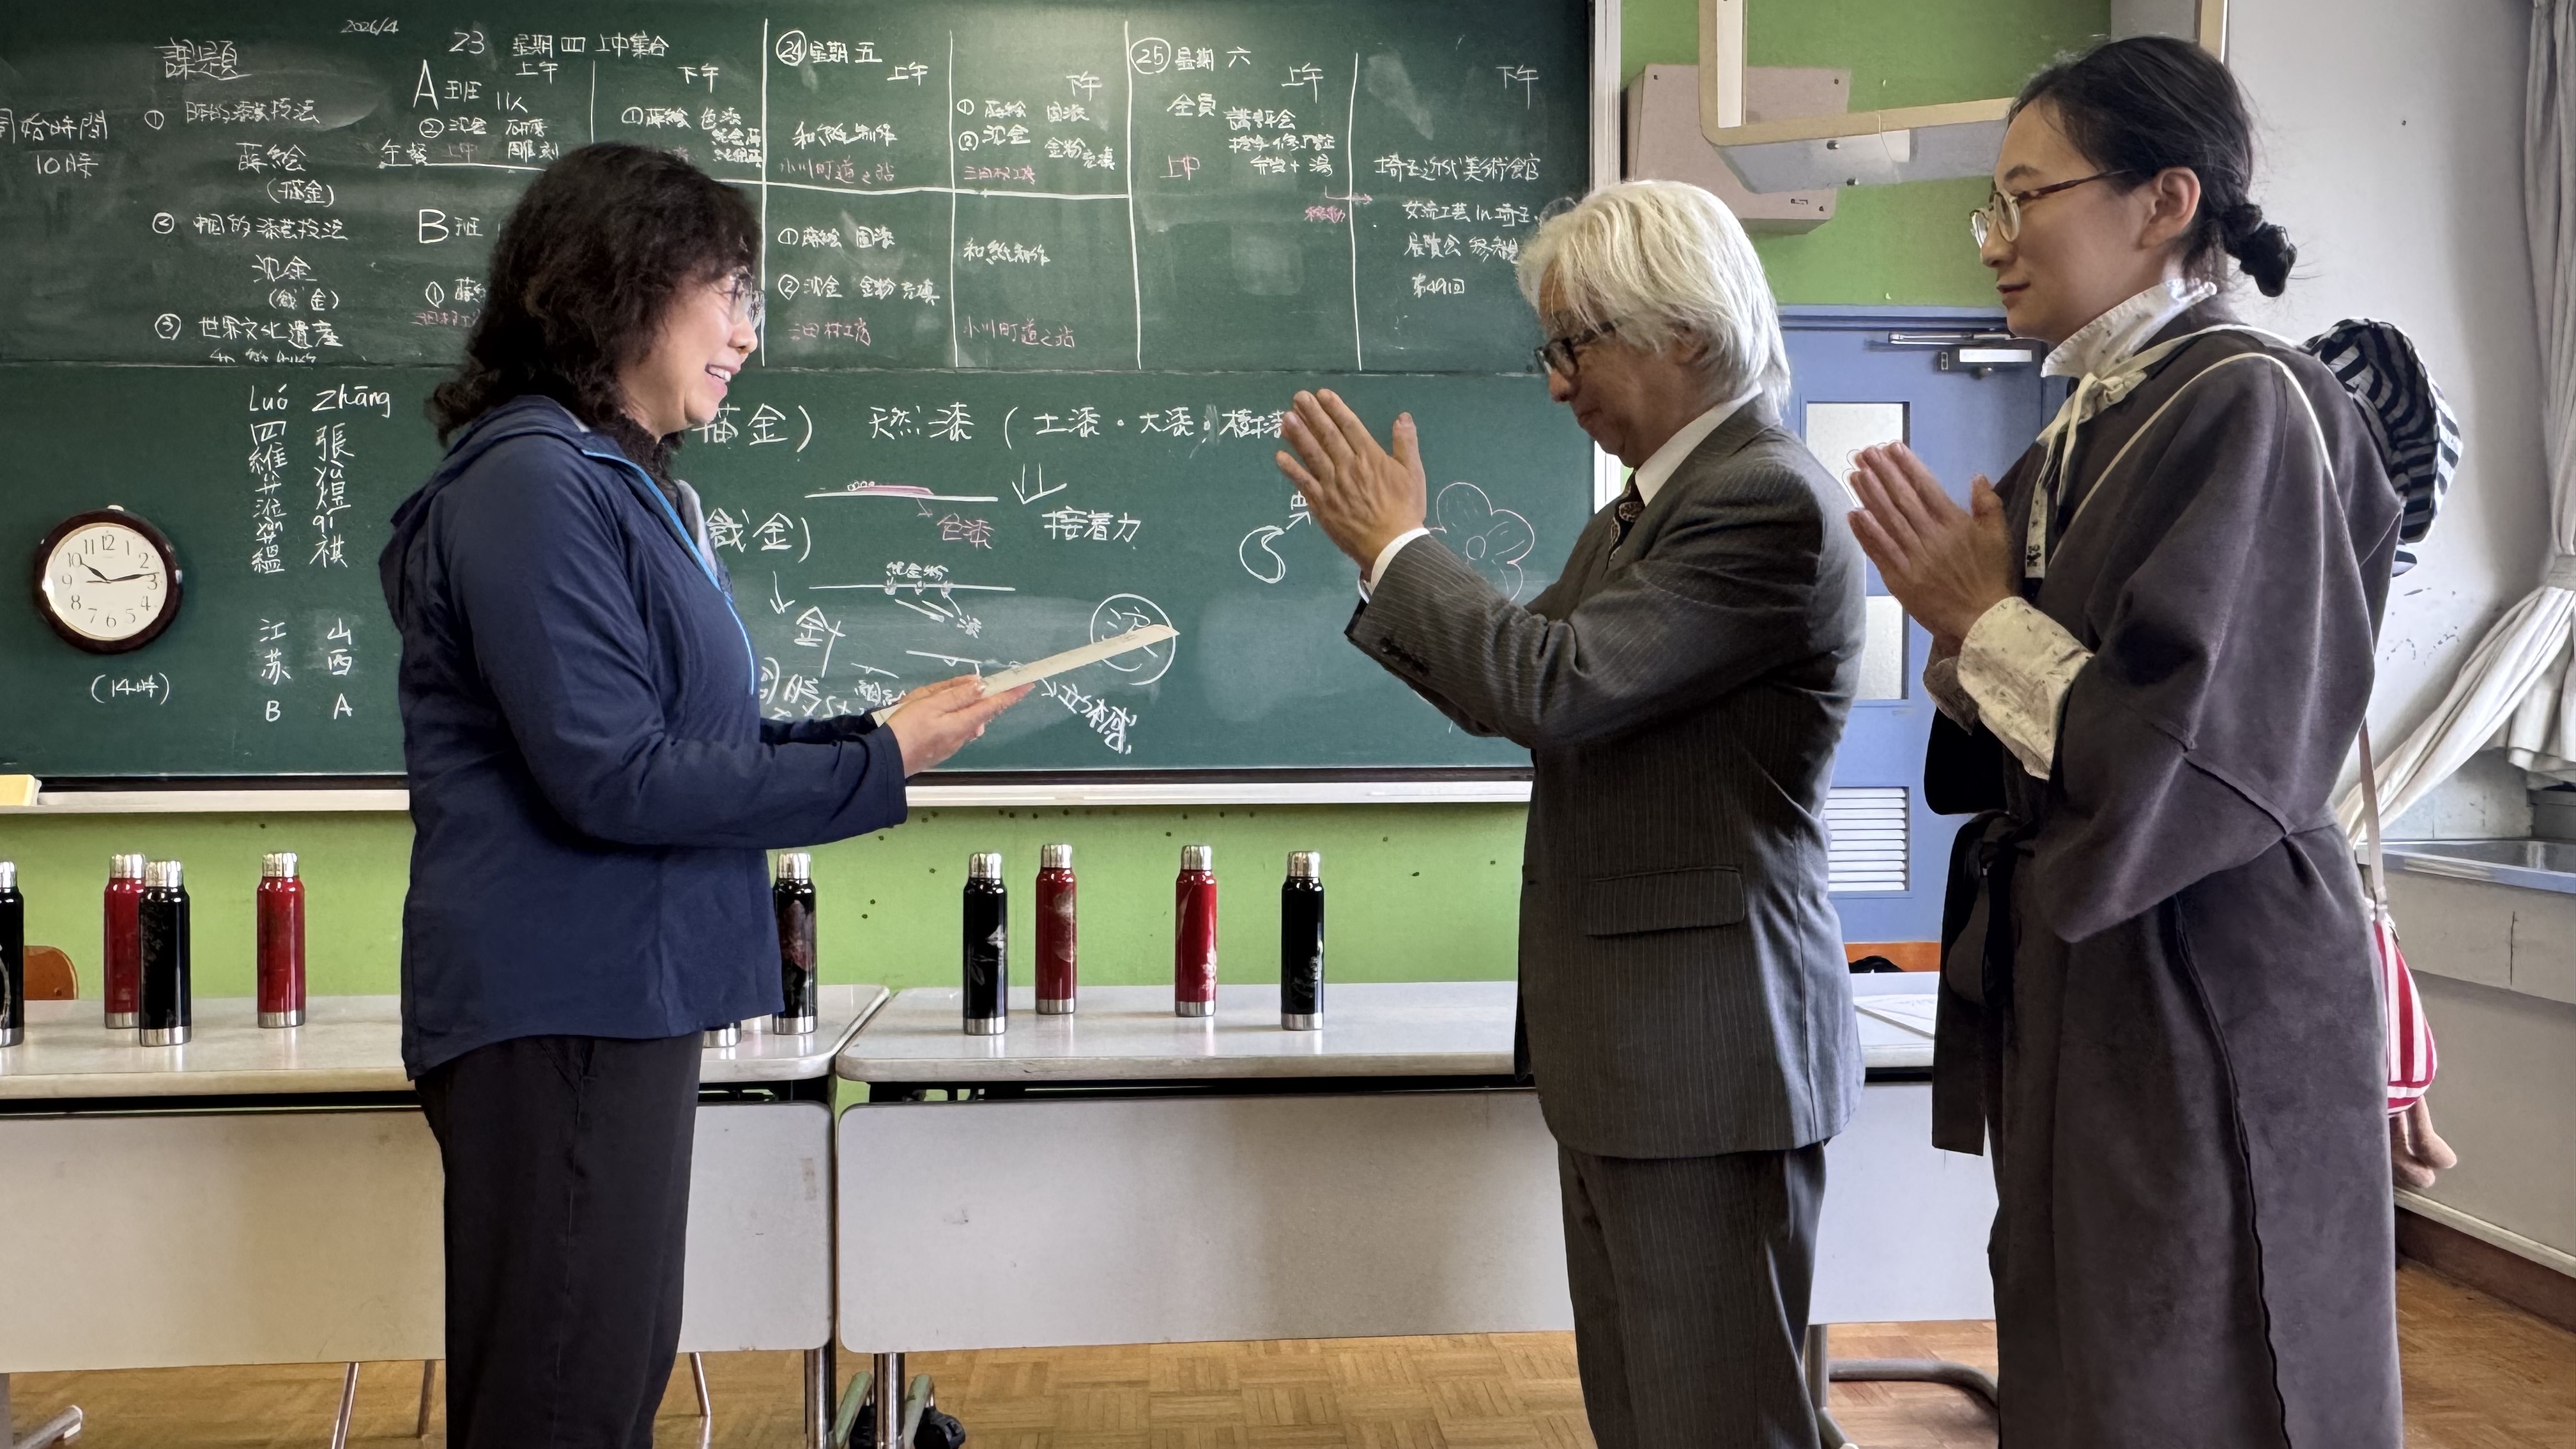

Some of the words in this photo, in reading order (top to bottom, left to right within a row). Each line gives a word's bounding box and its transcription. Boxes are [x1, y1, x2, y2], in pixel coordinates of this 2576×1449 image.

[340, 17, 399, 36] 2026/4
[448, 31, 485, 54] 23
[512, 34, 586, 58] 星期四
[809, 41, 882, 64] 星期五
[153, 37, 238, 80] 課題
[1175, 47, 1252, 72] 星期六
[515, 61, 558, 84] 上午
[677, 63, 719, 94] 下午
[887, 61, 928, 86] 上午
[1282, 63, 1324, 103] 上午
[1066, 71, 1103, 102] 下午
[1496, 65, 1539, 110] 下午
[1167, 93, 1216, 117] 全員
[311, 383, 390, 418] Zhāng
[1041, 505, 1141, 543] 接着力
[84, 539, 95, 555] 11
[102, 534, 115, 551] 12
[68, 552, 82, 568] 10
[139, 552, 149, 569] 2
[62, 574, 72, 590] 9
[146, 574, 158, 590] 3
[71, 594, 81, 610] 8
[141, 595, 151, 611] 4
[88, 608, 97, 624] 7
[106, 612, 116, 628] 6
[126, 608, 136, 624] 5
[265, 700, 281, 723] B
[334, 693, 353, 720] A
